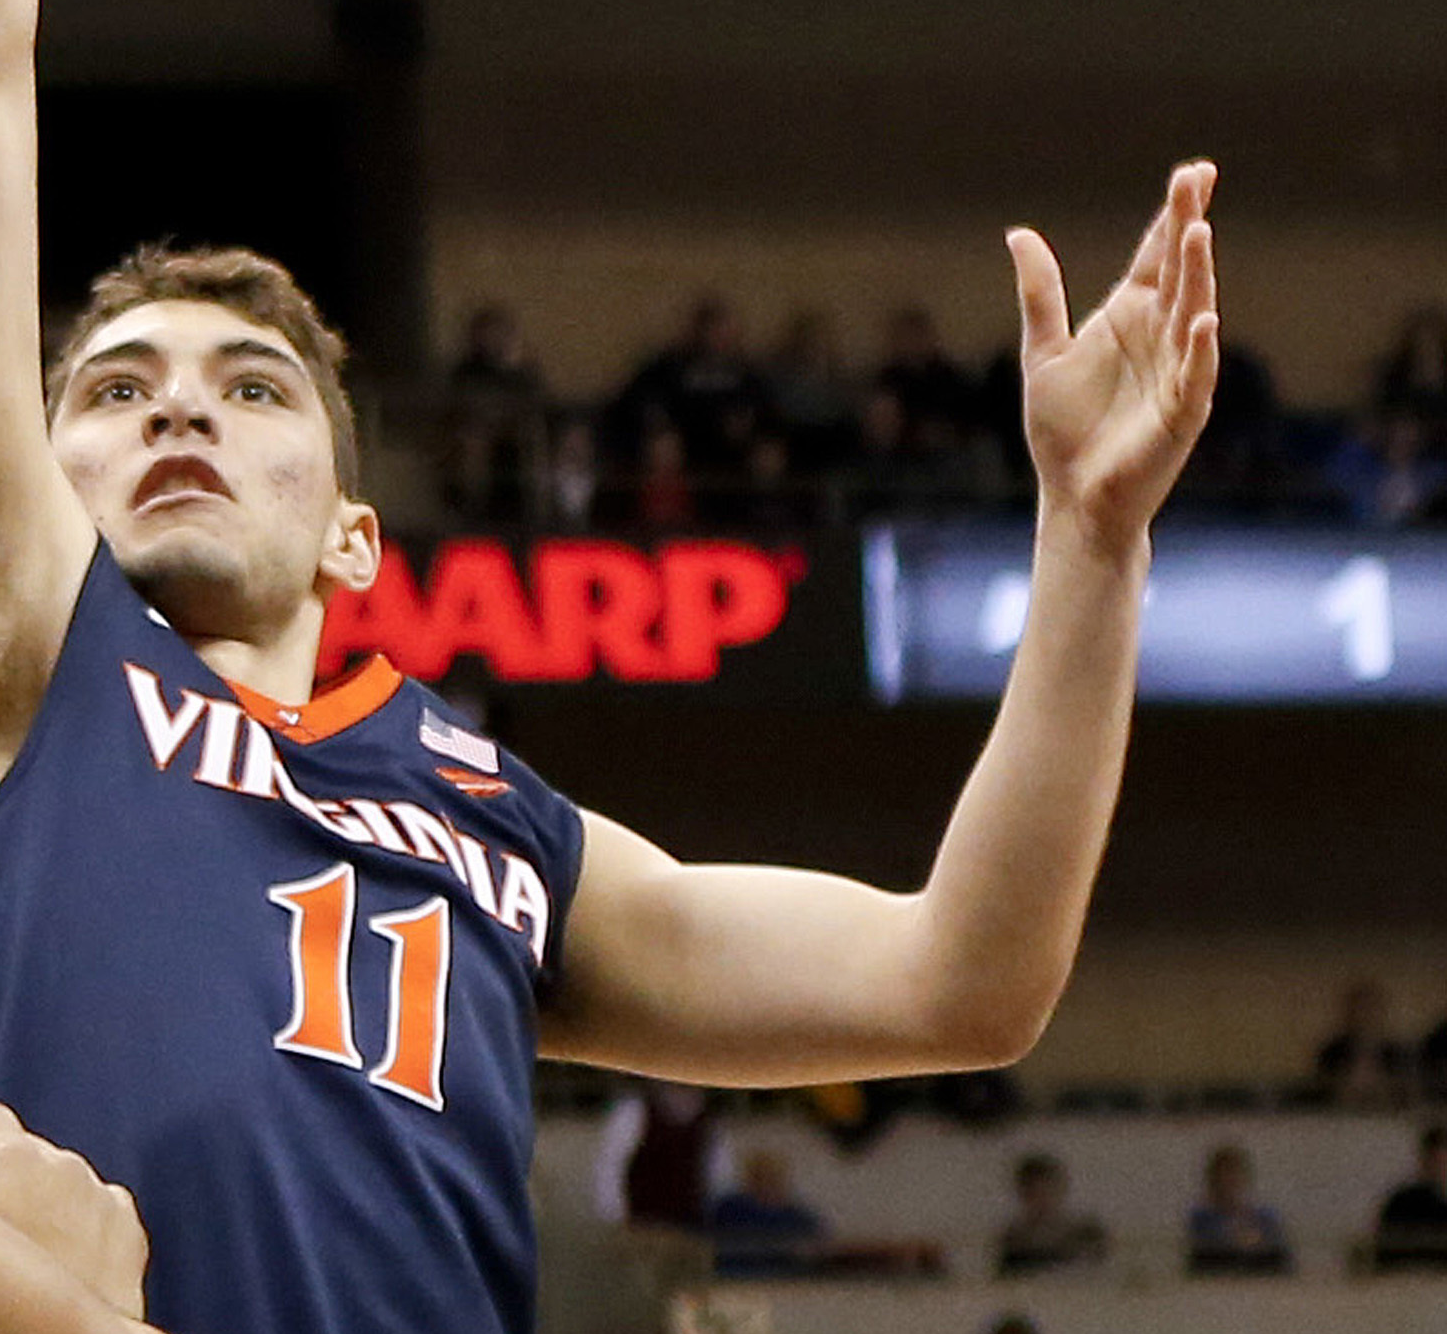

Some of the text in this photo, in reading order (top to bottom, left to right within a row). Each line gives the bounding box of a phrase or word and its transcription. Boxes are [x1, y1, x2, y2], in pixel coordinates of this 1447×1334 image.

[313, 535, 790, 682] AARP
[1317, 555, 1394, 680] 1
[267, 862, 450, 1112] 11
